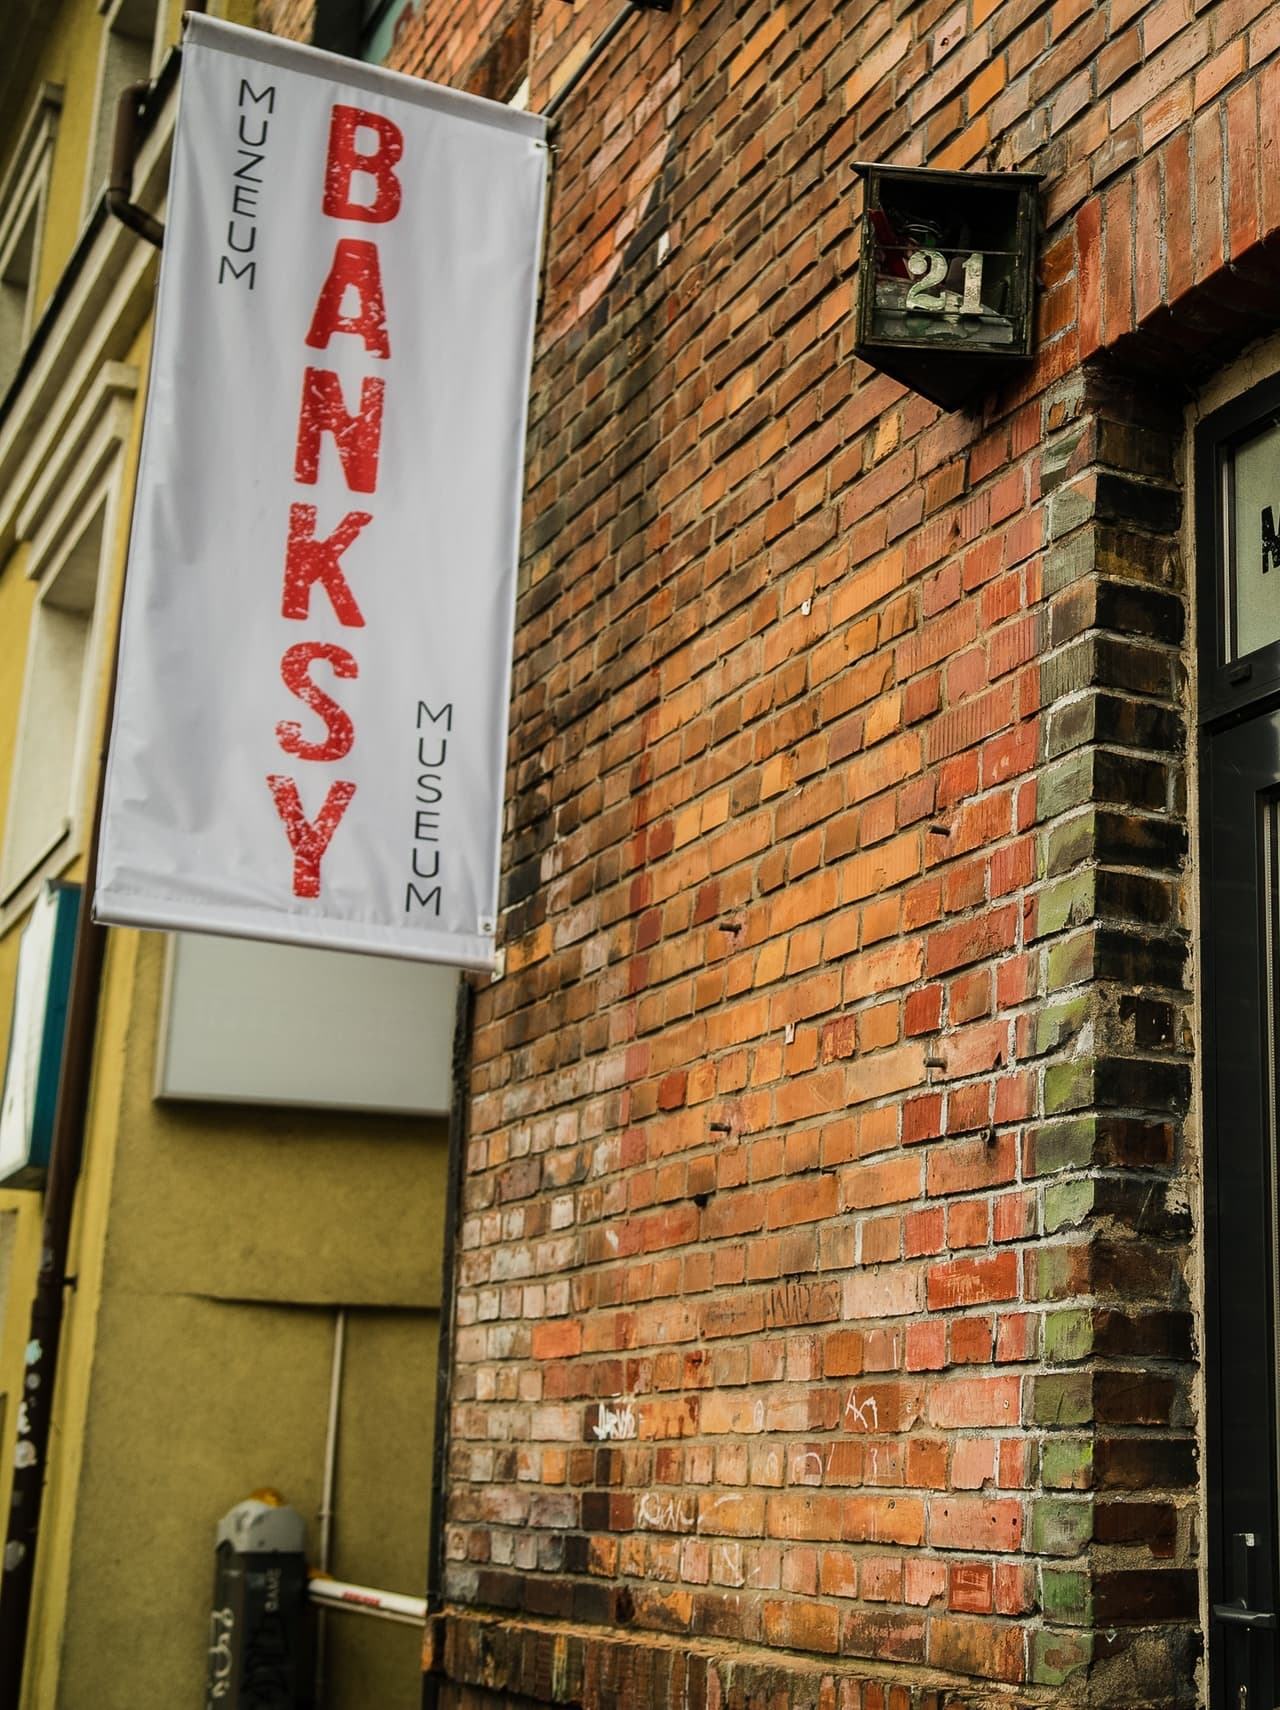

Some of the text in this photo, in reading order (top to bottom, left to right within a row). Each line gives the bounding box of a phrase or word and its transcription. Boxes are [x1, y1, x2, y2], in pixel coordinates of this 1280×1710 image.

[218, 79, 276, 291] MUZEUM
[906, 249, 984, 314] 21
[266, 103, 405, 899] BANKSY
[404, 700, 454, 916] MUSEUM
